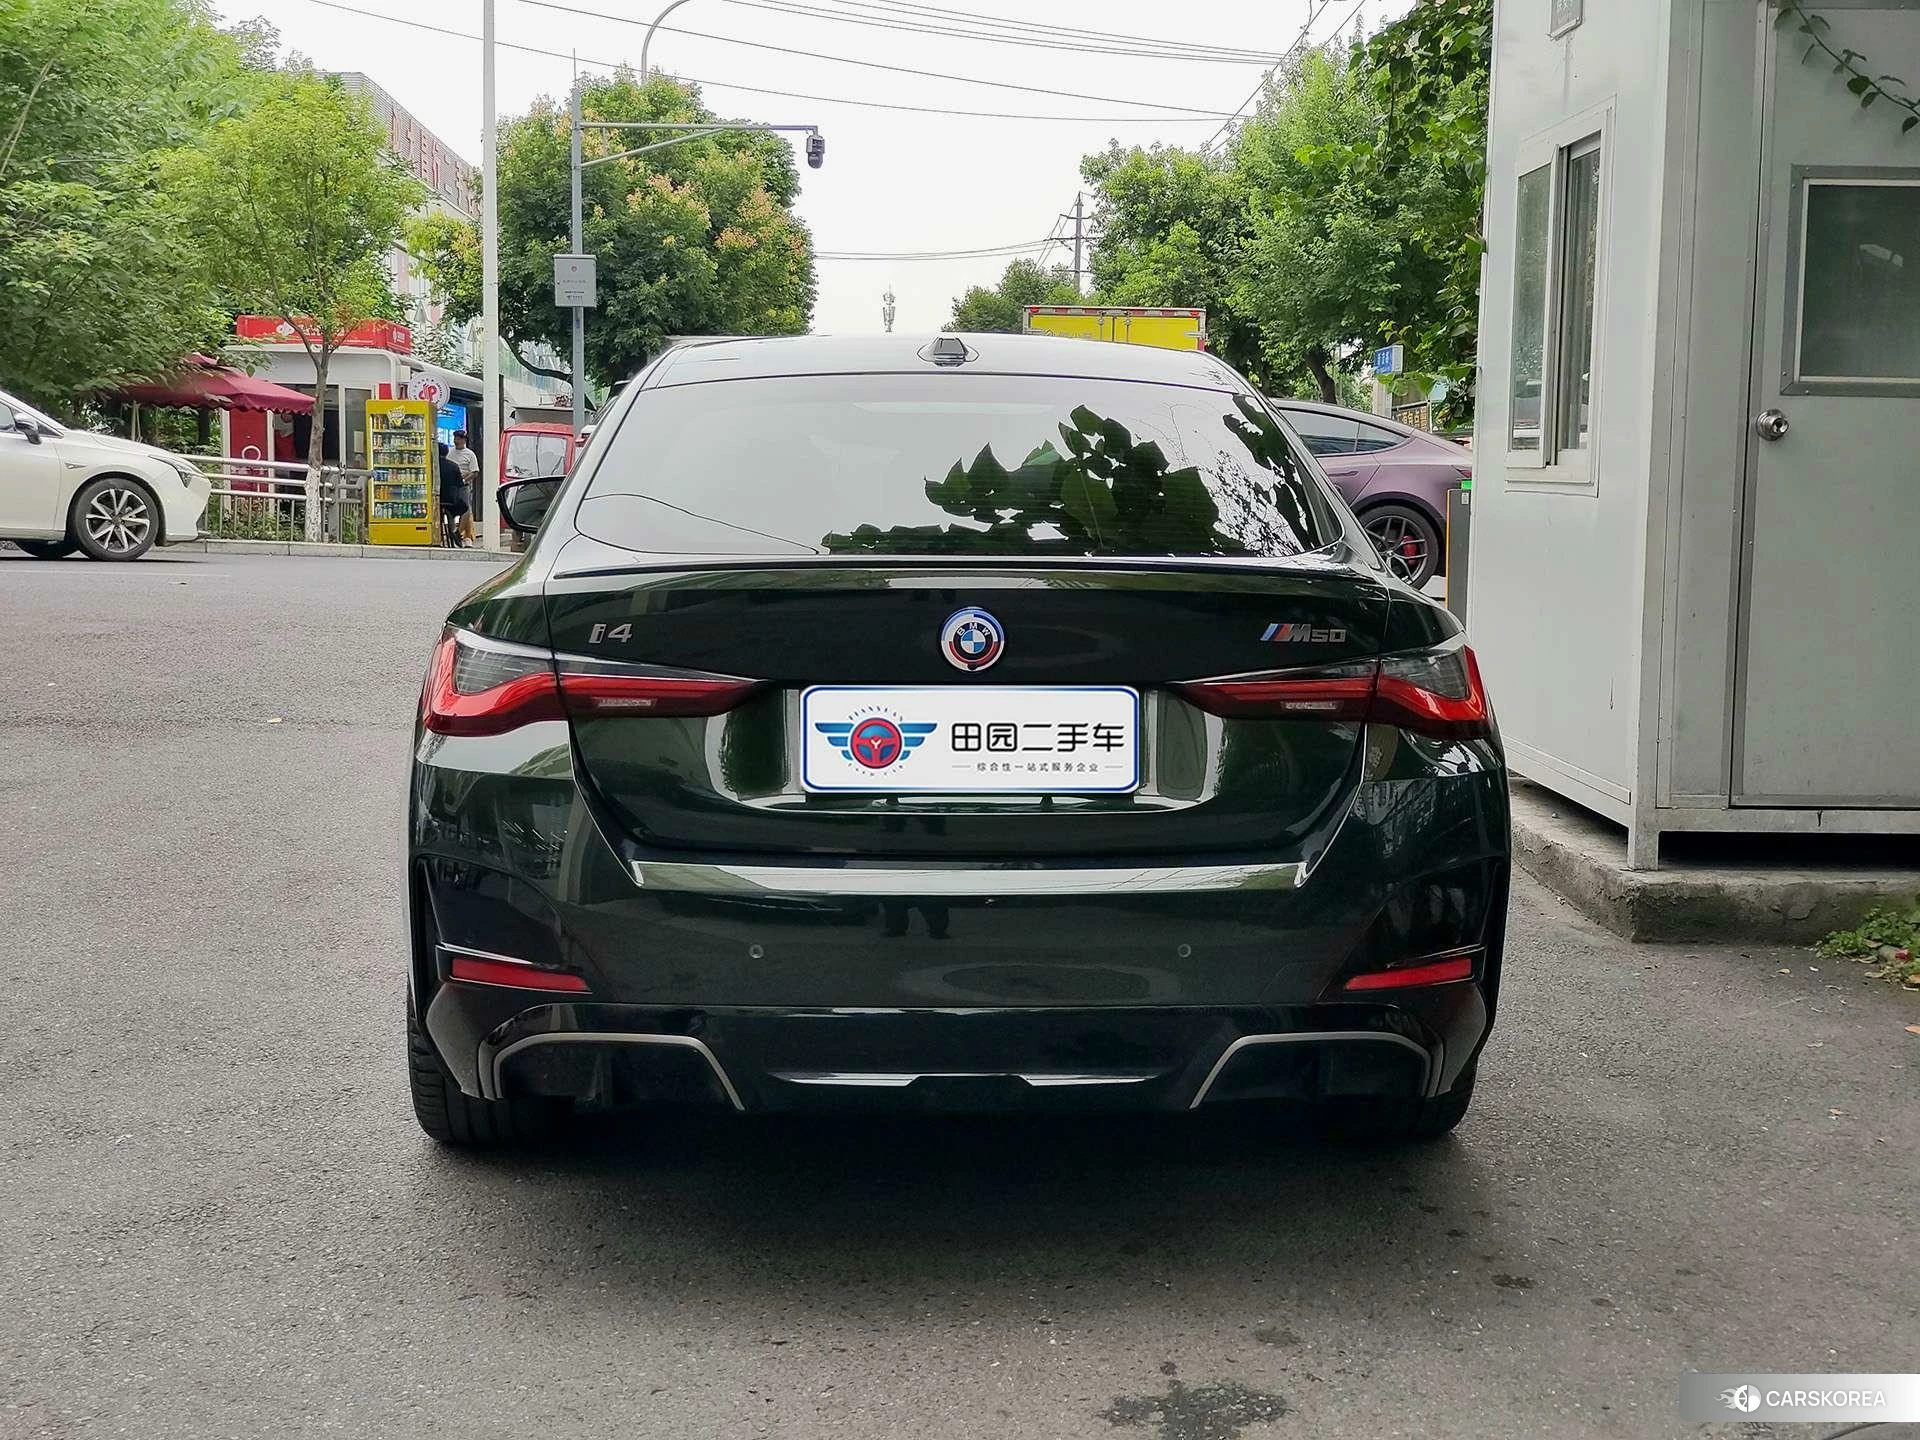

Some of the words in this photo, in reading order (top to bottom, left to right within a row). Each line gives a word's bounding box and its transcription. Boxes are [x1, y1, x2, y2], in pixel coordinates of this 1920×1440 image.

[588, 623, 633, 644] i4
[956, 622, 991, 637] BMW
[951, 722, 1125, 752] 田园二手车
[976, 761, 1099, 773] 综合性一站式服务企业
